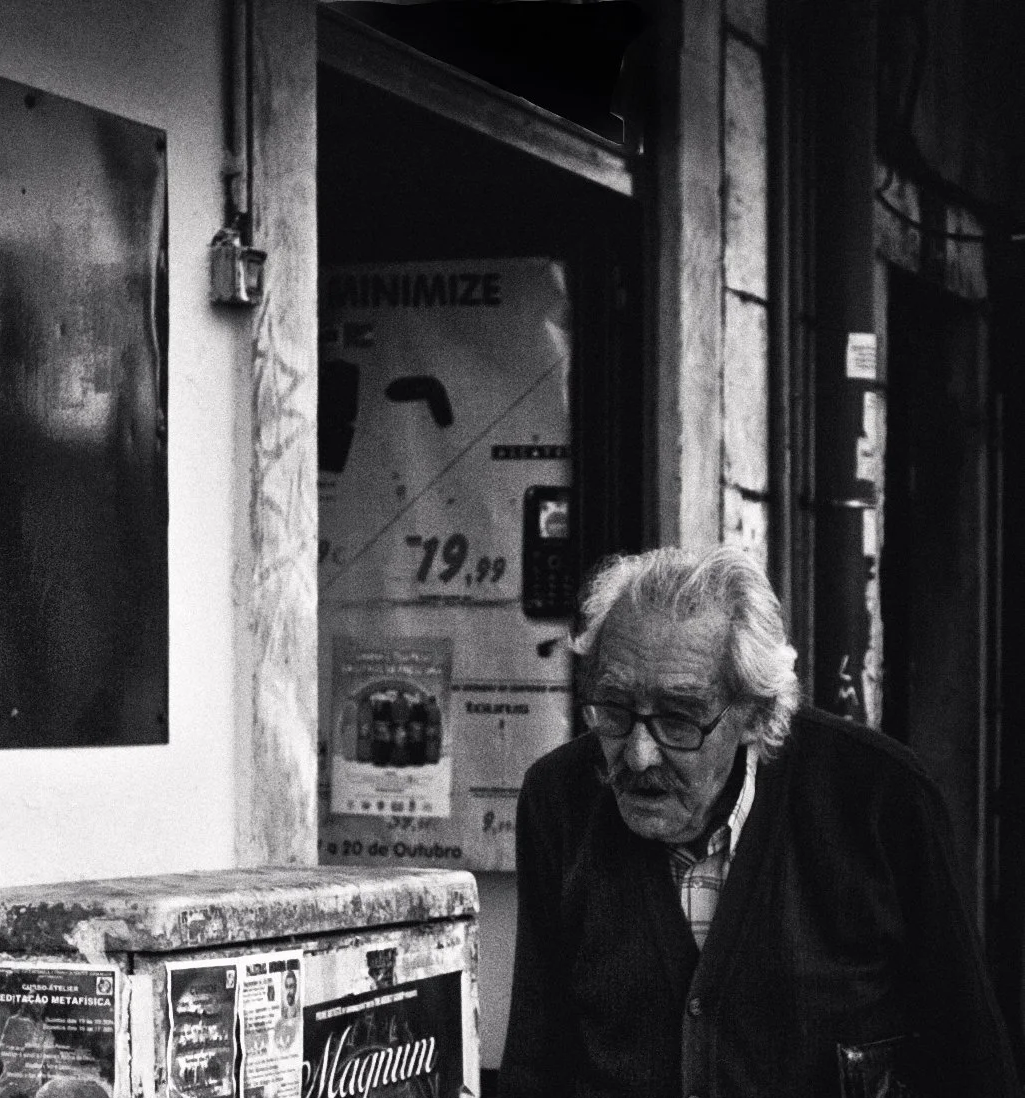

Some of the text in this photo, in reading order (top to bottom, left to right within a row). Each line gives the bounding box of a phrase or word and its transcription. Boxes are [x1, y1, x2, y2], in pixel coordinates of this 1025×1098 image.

[466, 701, 529, 714] taurus
[342, 840, 362, 856] 20
[368, 842, 389, 857] de
[393, 842, 463, 859] Outubro
[51, 996, 112, 1006] METAFÍSICA
